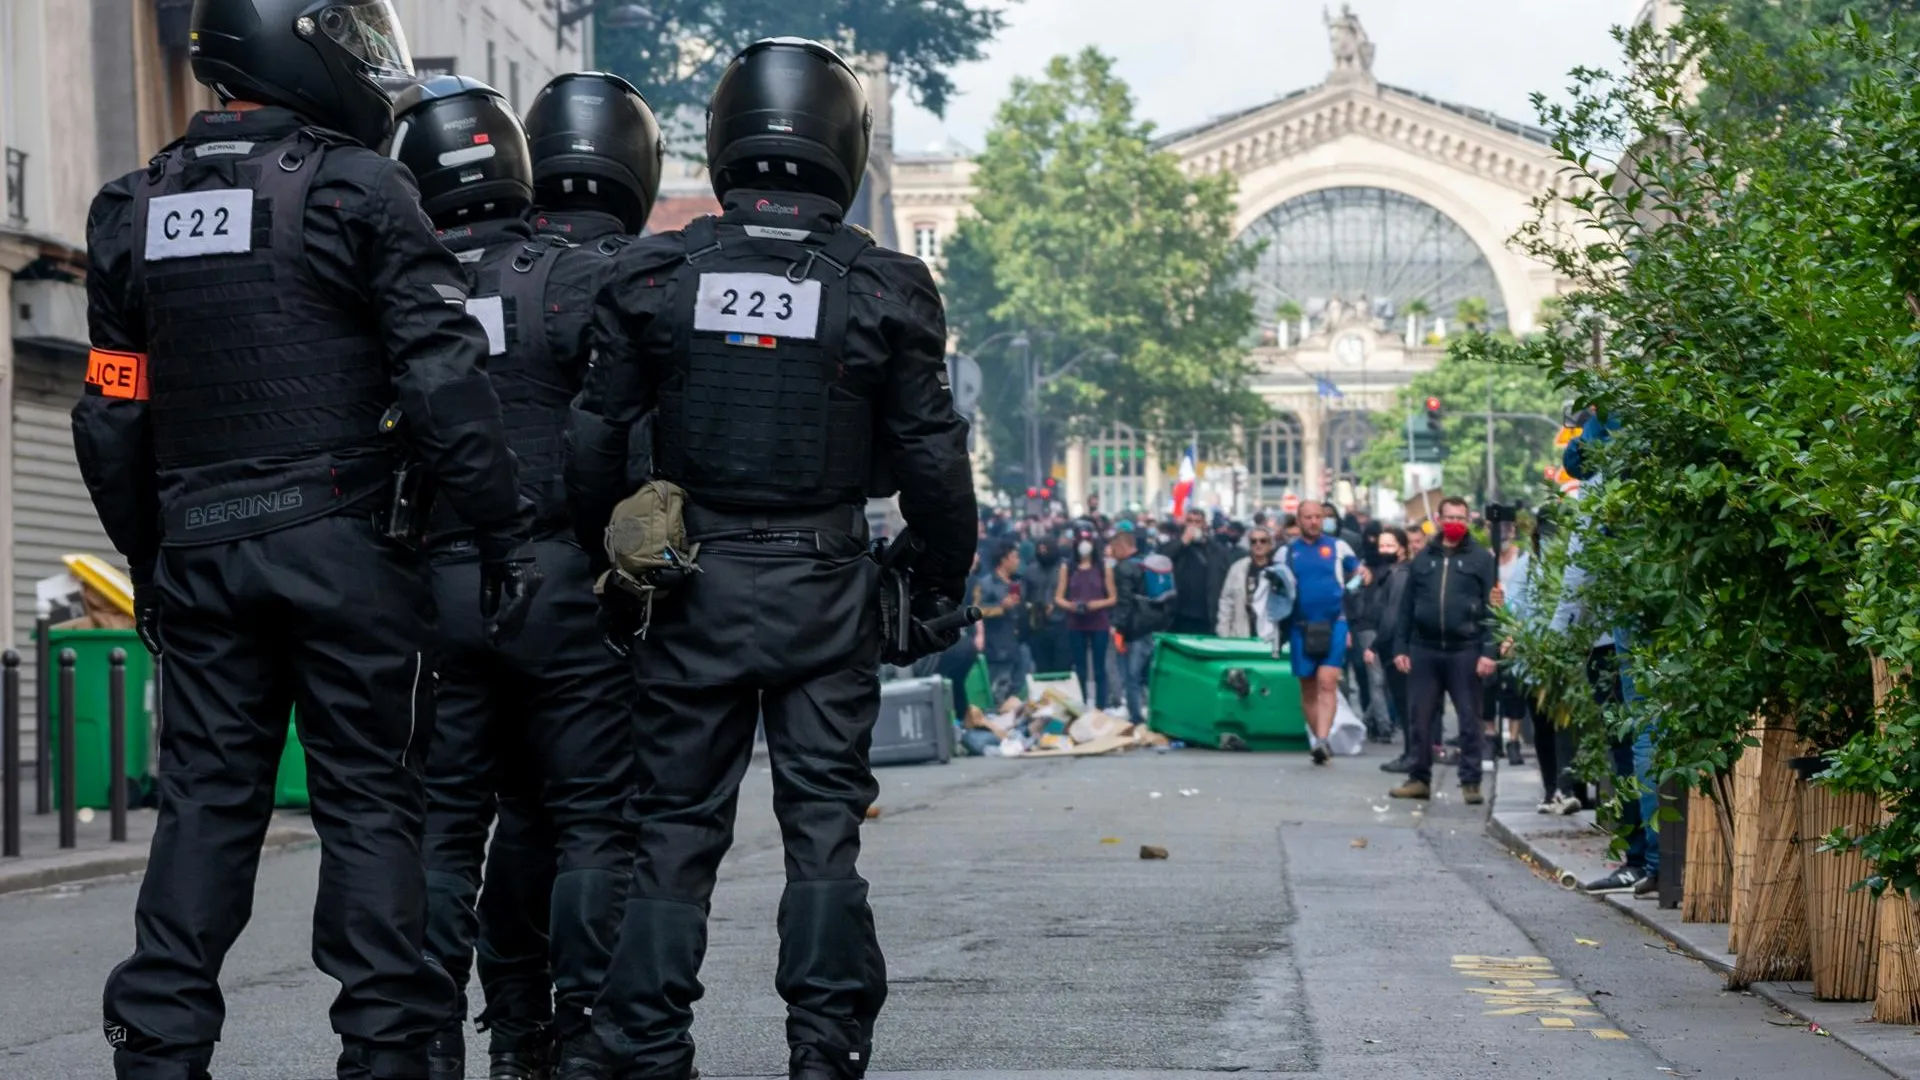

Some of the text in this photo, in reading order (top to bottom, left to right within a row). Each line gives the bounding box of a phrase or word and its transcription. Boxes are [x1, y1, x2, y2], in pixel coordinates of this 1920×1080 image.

[163, 206, 230, 241] C22
[720, 288, 794, 321] 223
[185, 485, 303, 529] BERING
